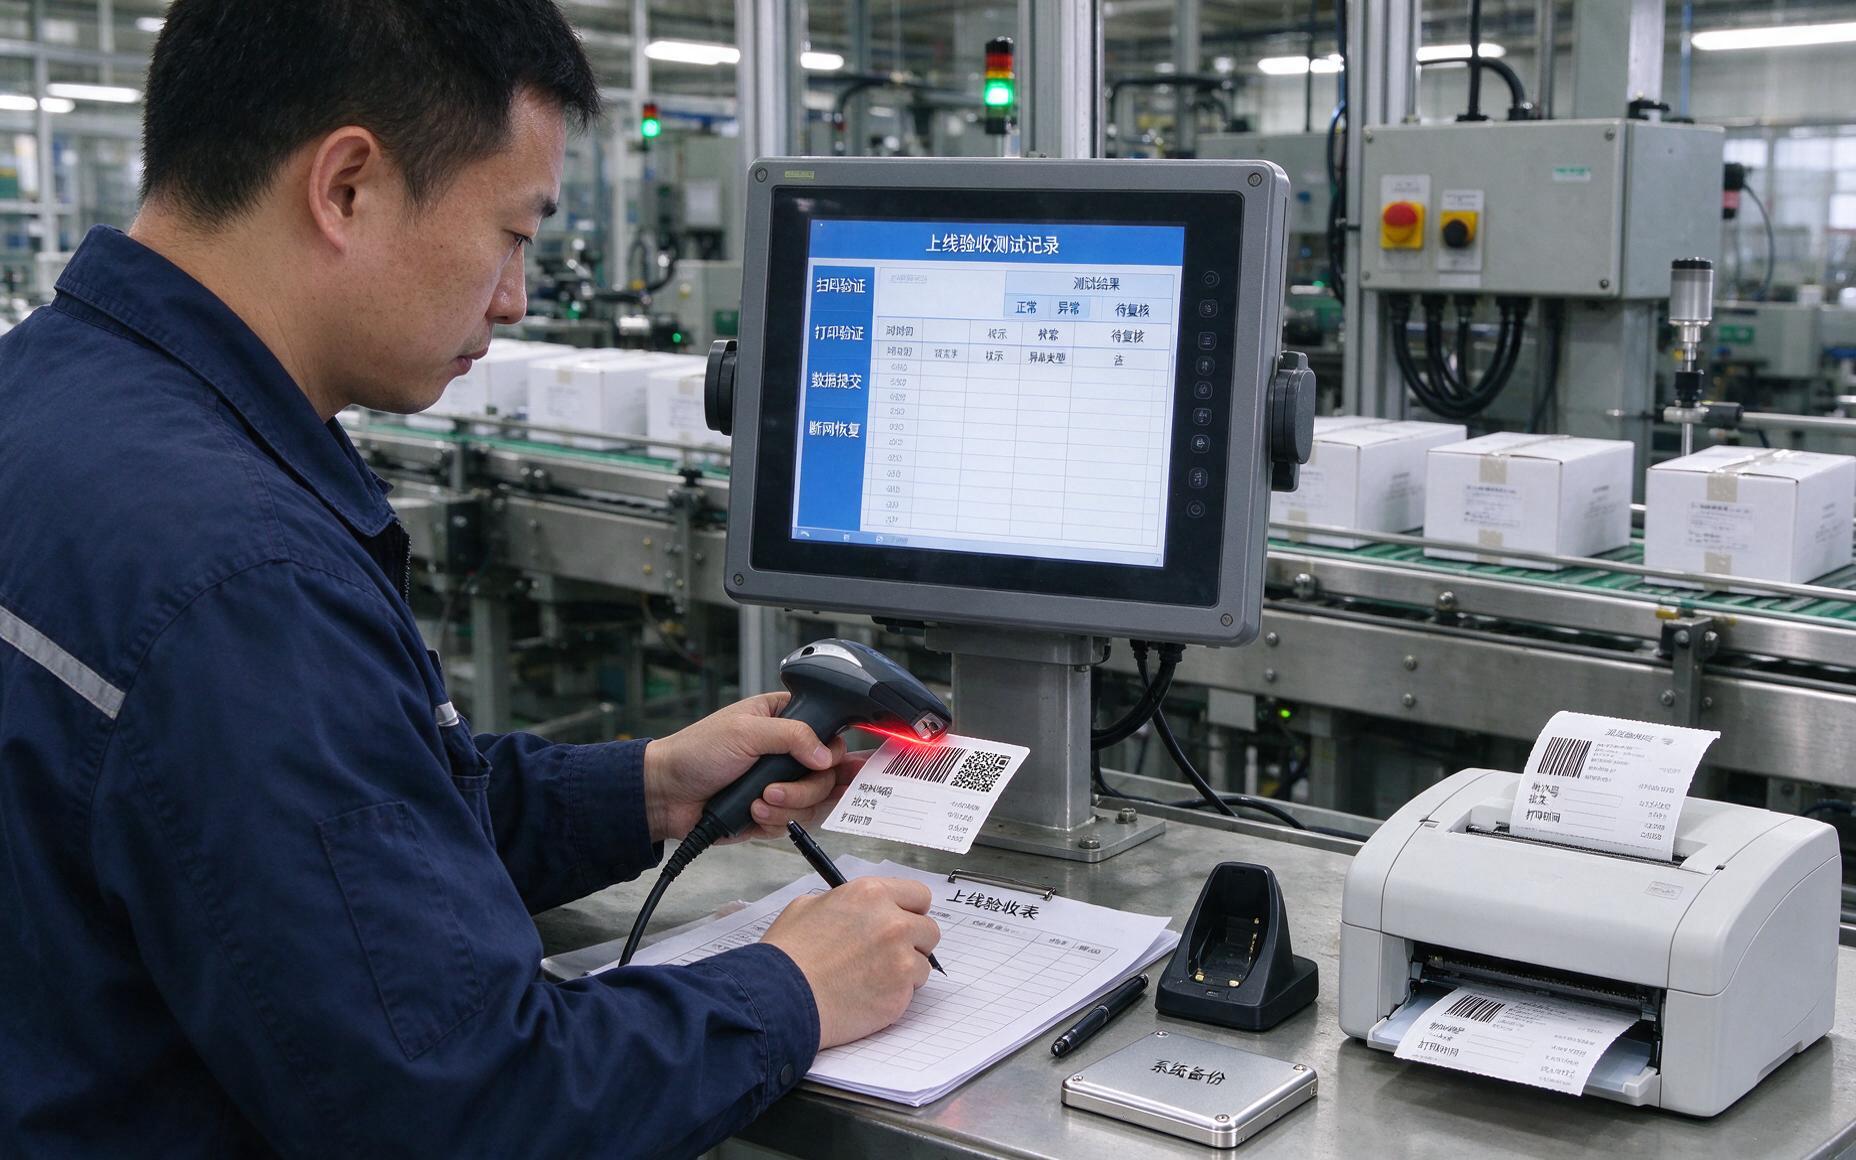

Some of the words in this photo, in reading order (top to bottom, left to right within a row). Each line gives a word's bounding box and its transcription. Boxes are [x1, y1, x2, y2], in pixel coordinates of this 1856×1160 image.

[925, 233, 1060, 257] 上线验收测试记录
[1015, 301, 1037, 314] 正常
[1057, 301, 1081, 315] 异常
[946, 889, 1040, 921] 上线验收表
